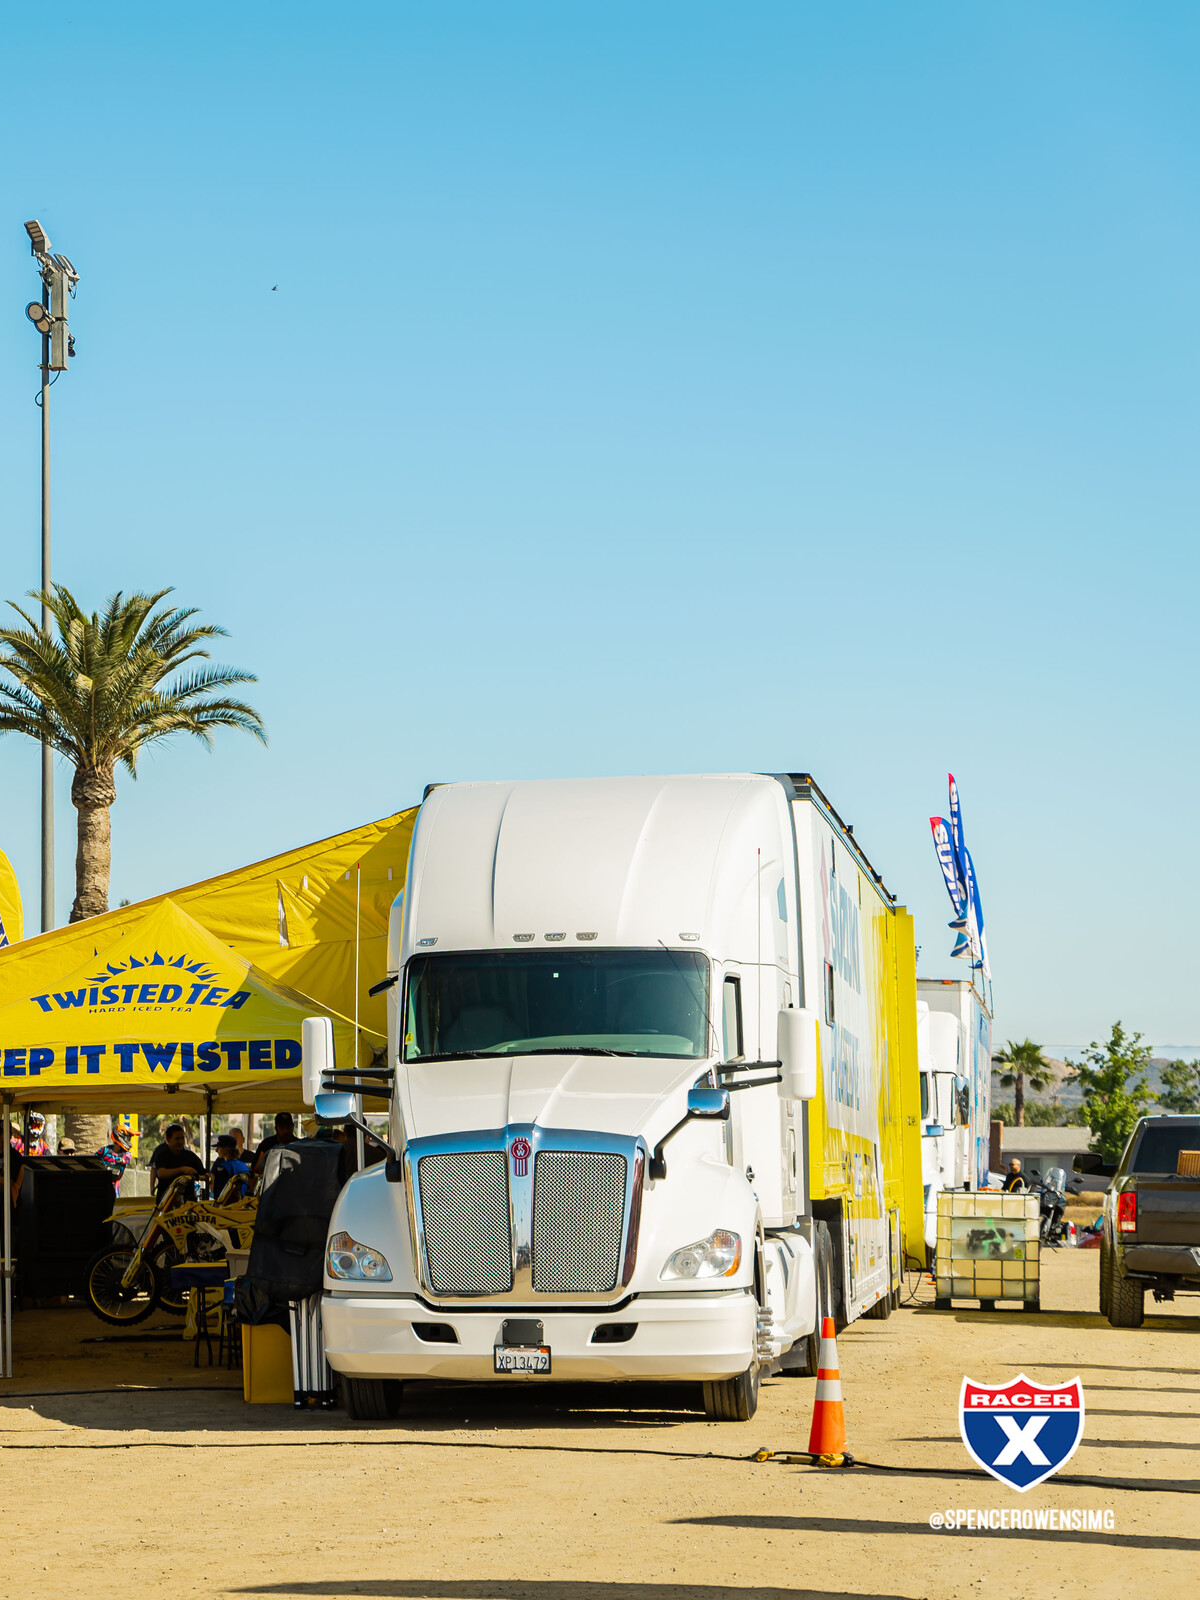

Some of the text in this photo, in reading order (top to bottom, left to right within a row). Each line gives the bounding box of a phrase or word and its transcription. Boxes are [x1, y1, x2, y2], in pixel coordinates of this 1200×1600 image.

[30, 983, 252, 1013] TWISTED TEA
[89, 1006, 126, 1014] HARD
[65, 1045, 106, 1074] IT
[113, 1039, 302, 1074] TWISTED
[498, 1355, 548, 1370] XP13479
